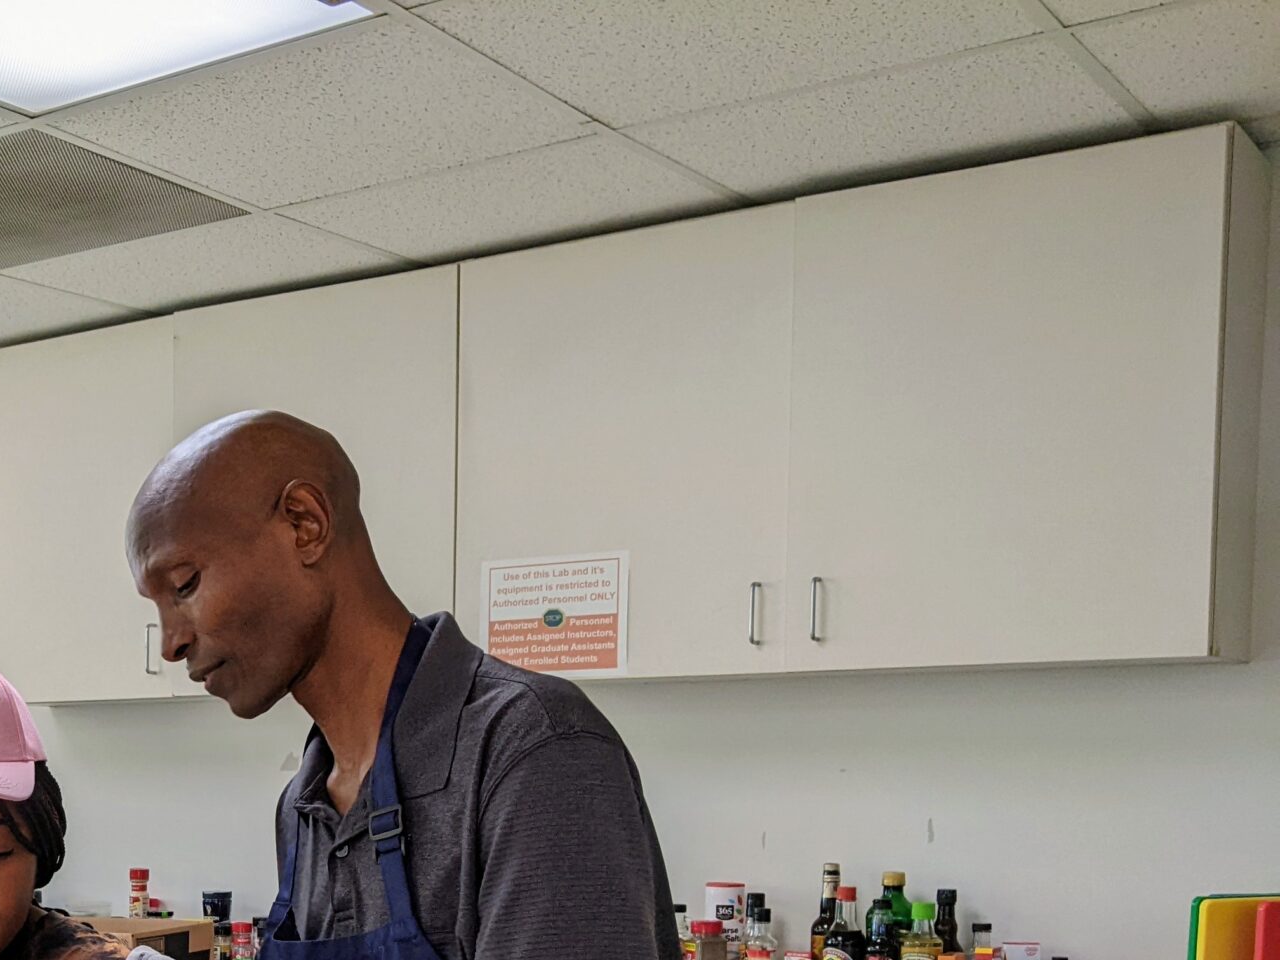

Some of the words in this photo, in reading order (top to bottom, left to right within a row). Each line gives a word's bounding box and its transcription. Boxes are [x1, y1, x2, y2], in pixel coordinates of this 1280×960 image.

[503, 572, 520, 582] Use
[522, 571, 532, 580] of
[533, 570, 550, 579] this
[552, 568, 570, 578] Lab
[571, 568, 588, 576] and
[591, 566, 604, 575] it's
[496, 584, 542, 596] equipment
[545, 583, 553, 592] is
[556, 580, 598, 590] restricted
[601, 580, 611, 588] to
[492, 598, 539, 608] Authorized
[542, 595, 587, 604] Personnel
[590, 592, 616, 601] ONLY
[494, 622, 538, 630] Authorized
[569, 617, 613, 626] Personnel
[546, 614, 562, 622] STOP
[490, 634, 524, 643] includes
[526, 632, 566, 642] Assigned
[568, 630, 616, 639] Instructors,
[491, 646, 529, 656] Assigned
[530, 644, 570, 653] Graduate
[571, 641, 616, 650] Assistants
[524, 656, 560, 666] Enrolled
[560, 654, 598, 664] Students
[725, 934, 740, 942] Salt
